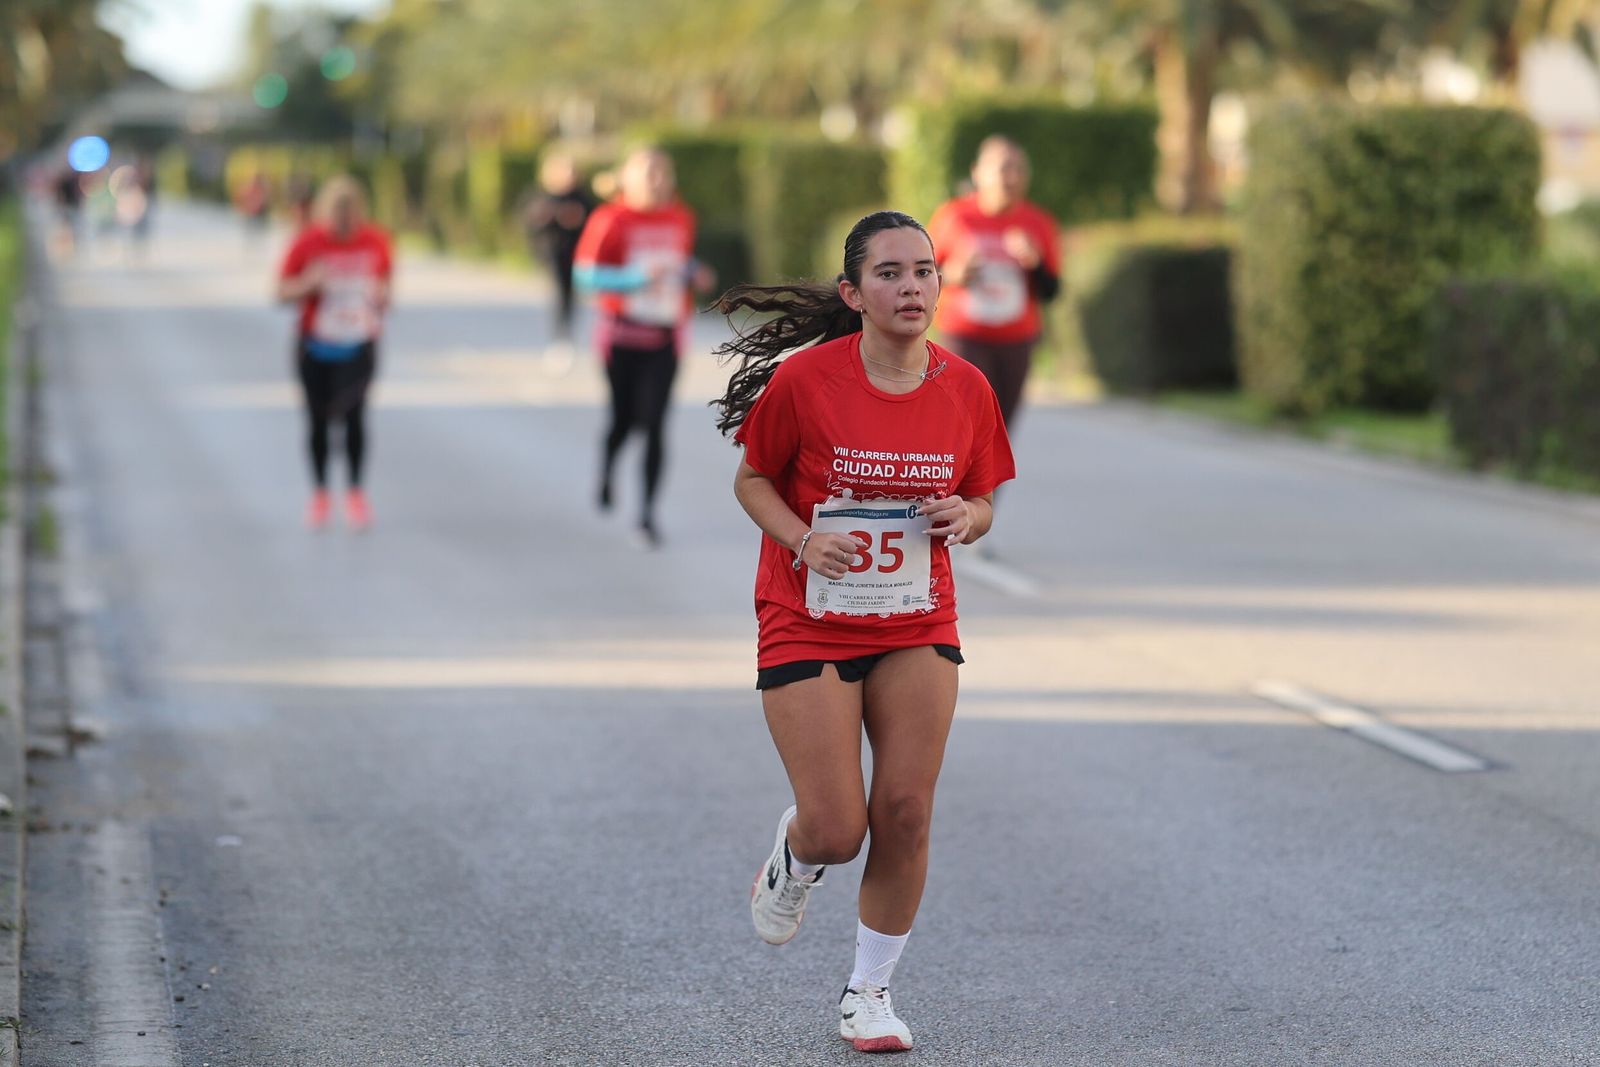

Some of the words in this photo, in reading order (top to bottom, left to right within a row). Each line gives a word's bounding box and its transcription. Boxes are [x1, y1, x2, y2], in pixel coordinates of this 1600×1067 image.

[833, 446, 849, 457] VIII
[851, 450, 900, 461] CARRERA
[902, 453, 942, 462] URBANA
[943, 454, 954, 462] DE
[833, 458, 895, 478] CIUDAD
[899, 462, 953, 480] JARDÍN
[837, 475, 859, 484] Colegio
[859, 478, 888, 486] Fundación
[909, 480, 932, 488] Sagrada
